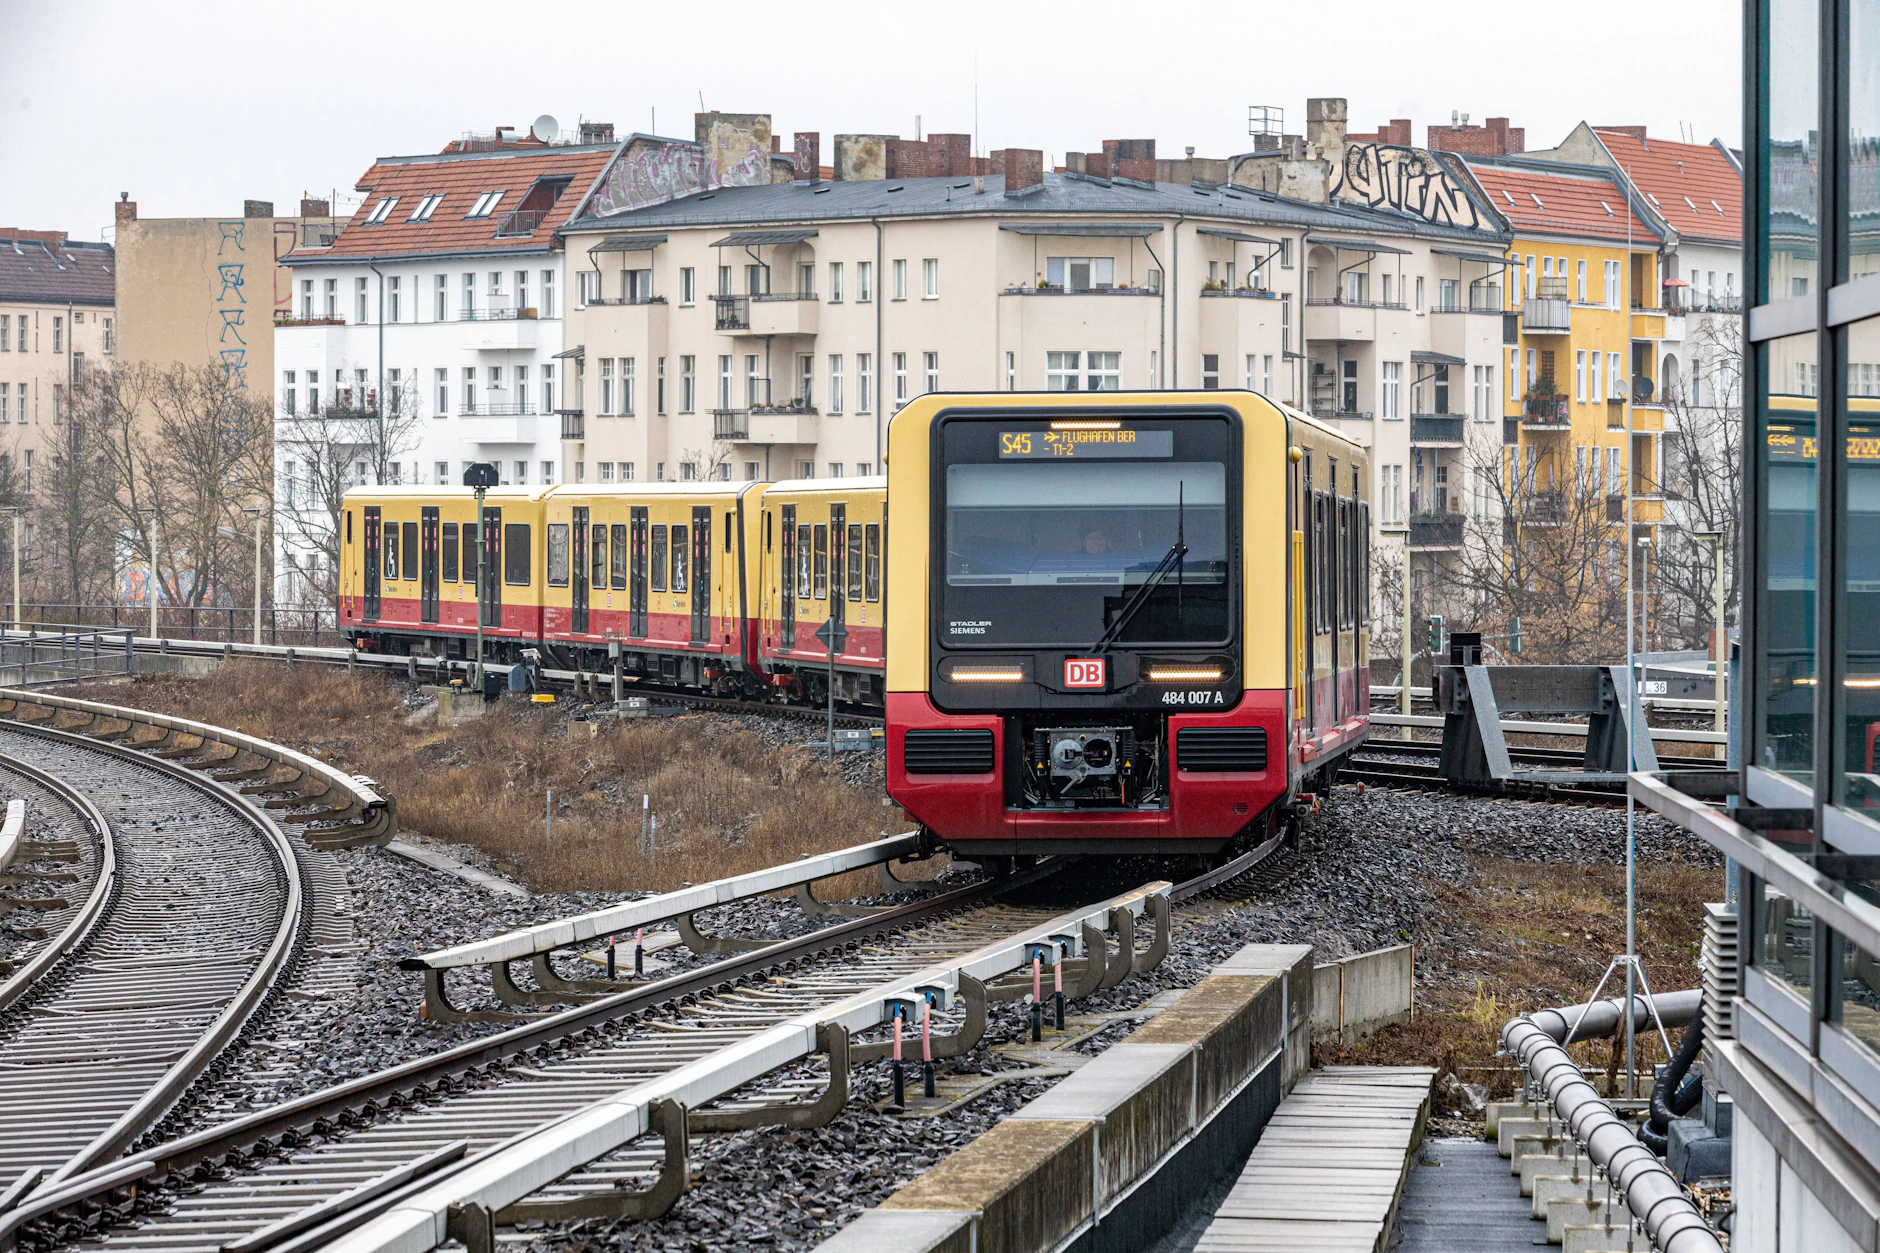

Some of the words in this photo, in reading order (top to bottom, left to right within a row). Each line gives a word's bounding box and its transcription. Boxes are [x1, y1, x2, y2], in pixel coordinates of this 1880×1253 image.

[1062, 430, 1115, 443] FLUGHAFEN
[1117, 430, 1136, 443] BER
[1002, 433, 1032, 454] S45
[1053, 443, 1074, 456] T1-2
[949, 627, 986, 635] SIEMENS
[1069, 663, 1100, 683] DB
[1653, 682, 1666, 693] 36
[1161, 691, 1186, 704] 484
[1188, 691, 1212, 704] 007
[1213, 691, 1224, 704] A
